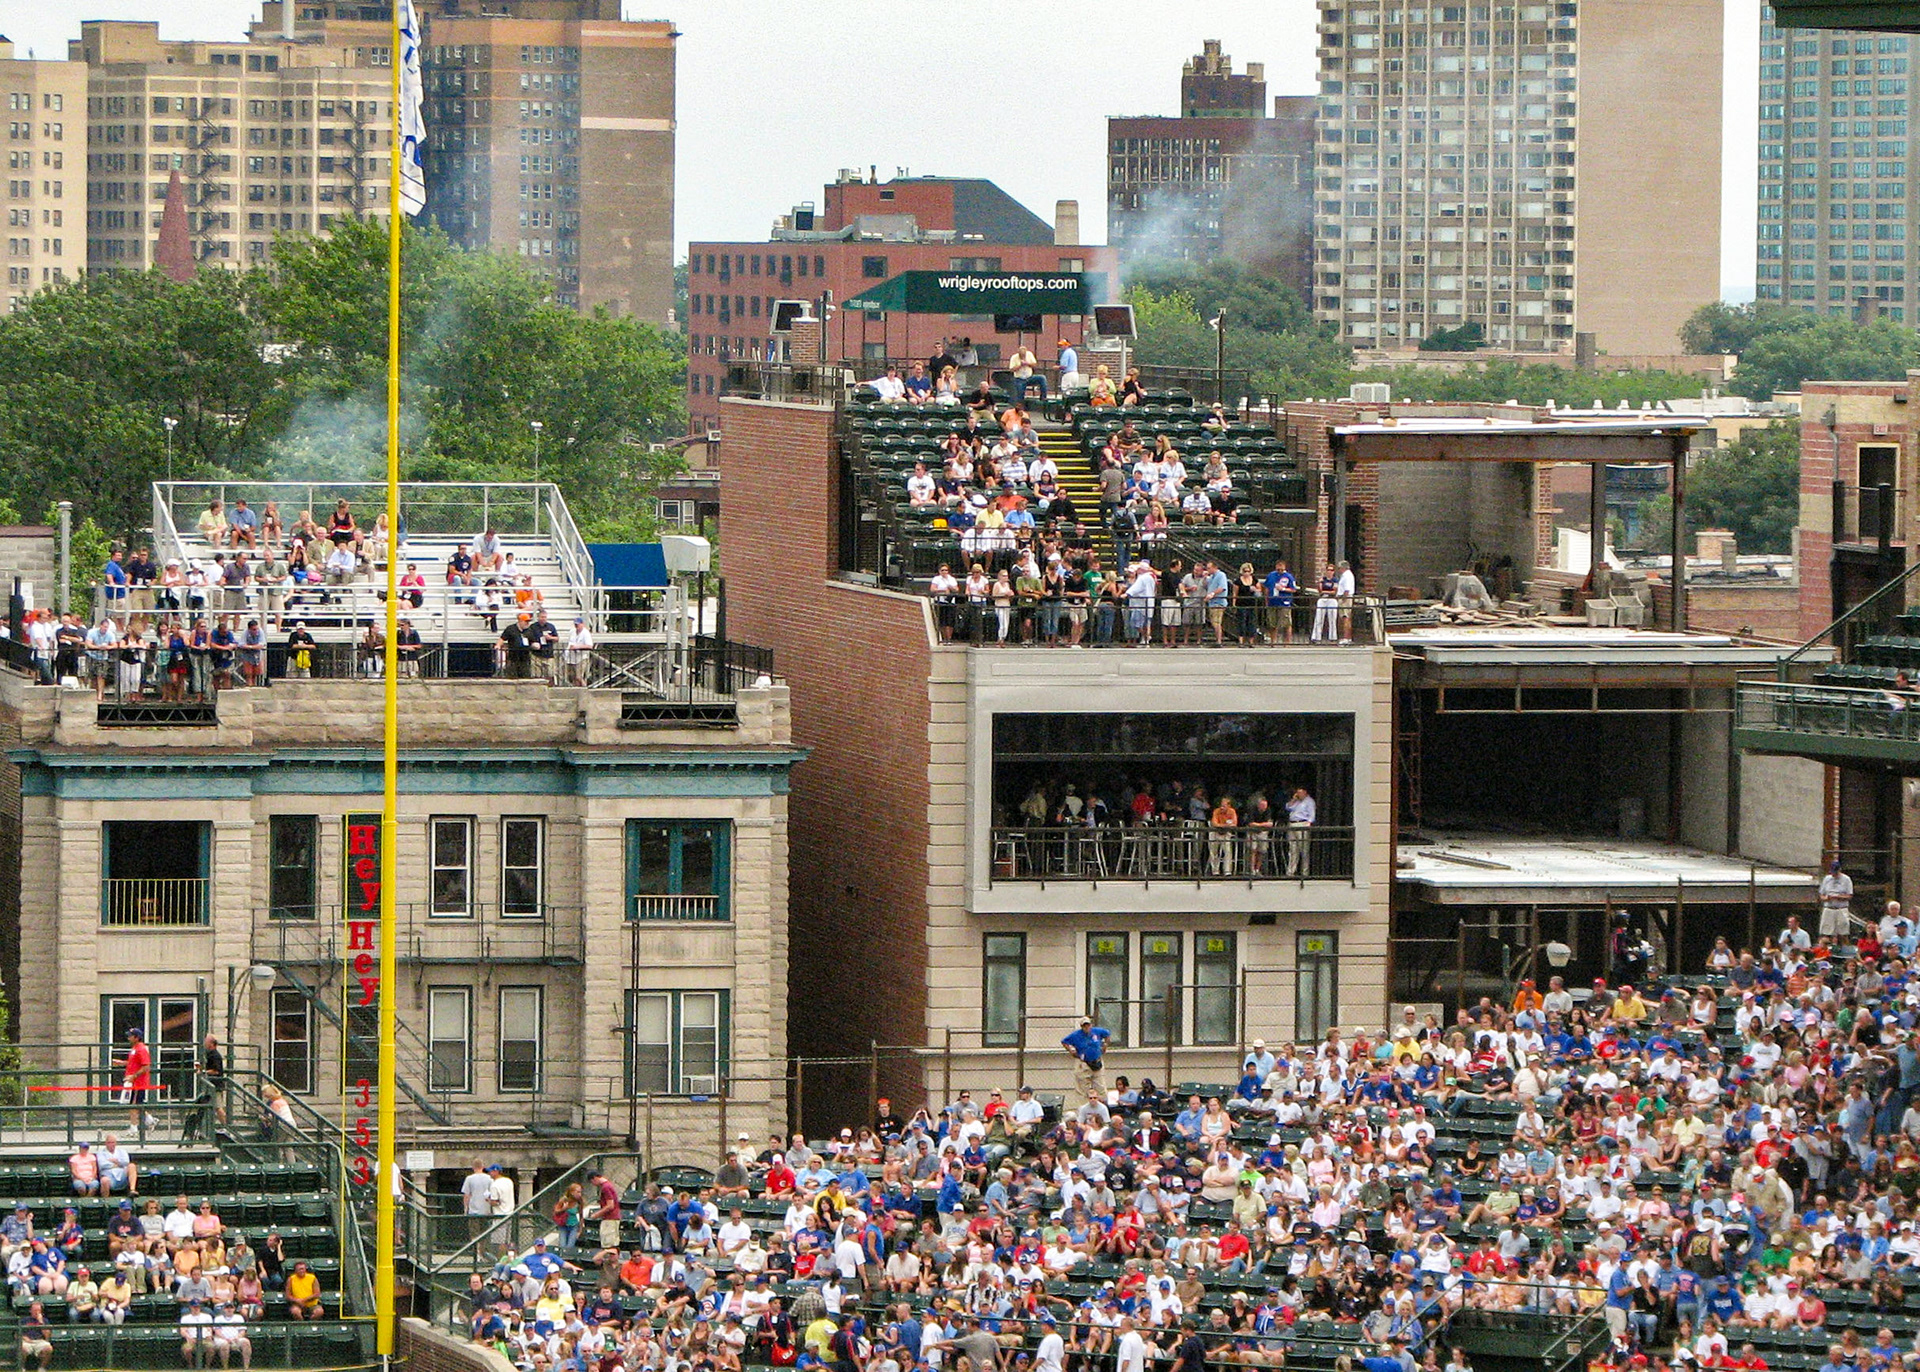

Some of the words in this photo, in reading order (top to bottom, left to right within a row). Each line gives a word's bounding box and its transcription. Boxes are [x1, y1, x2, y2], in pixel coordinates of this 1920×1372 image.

[938, 275, 1078, 292] wrigleyrooftops.com
[348, 825, 381, 910] Hey
[347, 921, 380, 1006] Hey
[353, 1078, 371, 1185] 353
